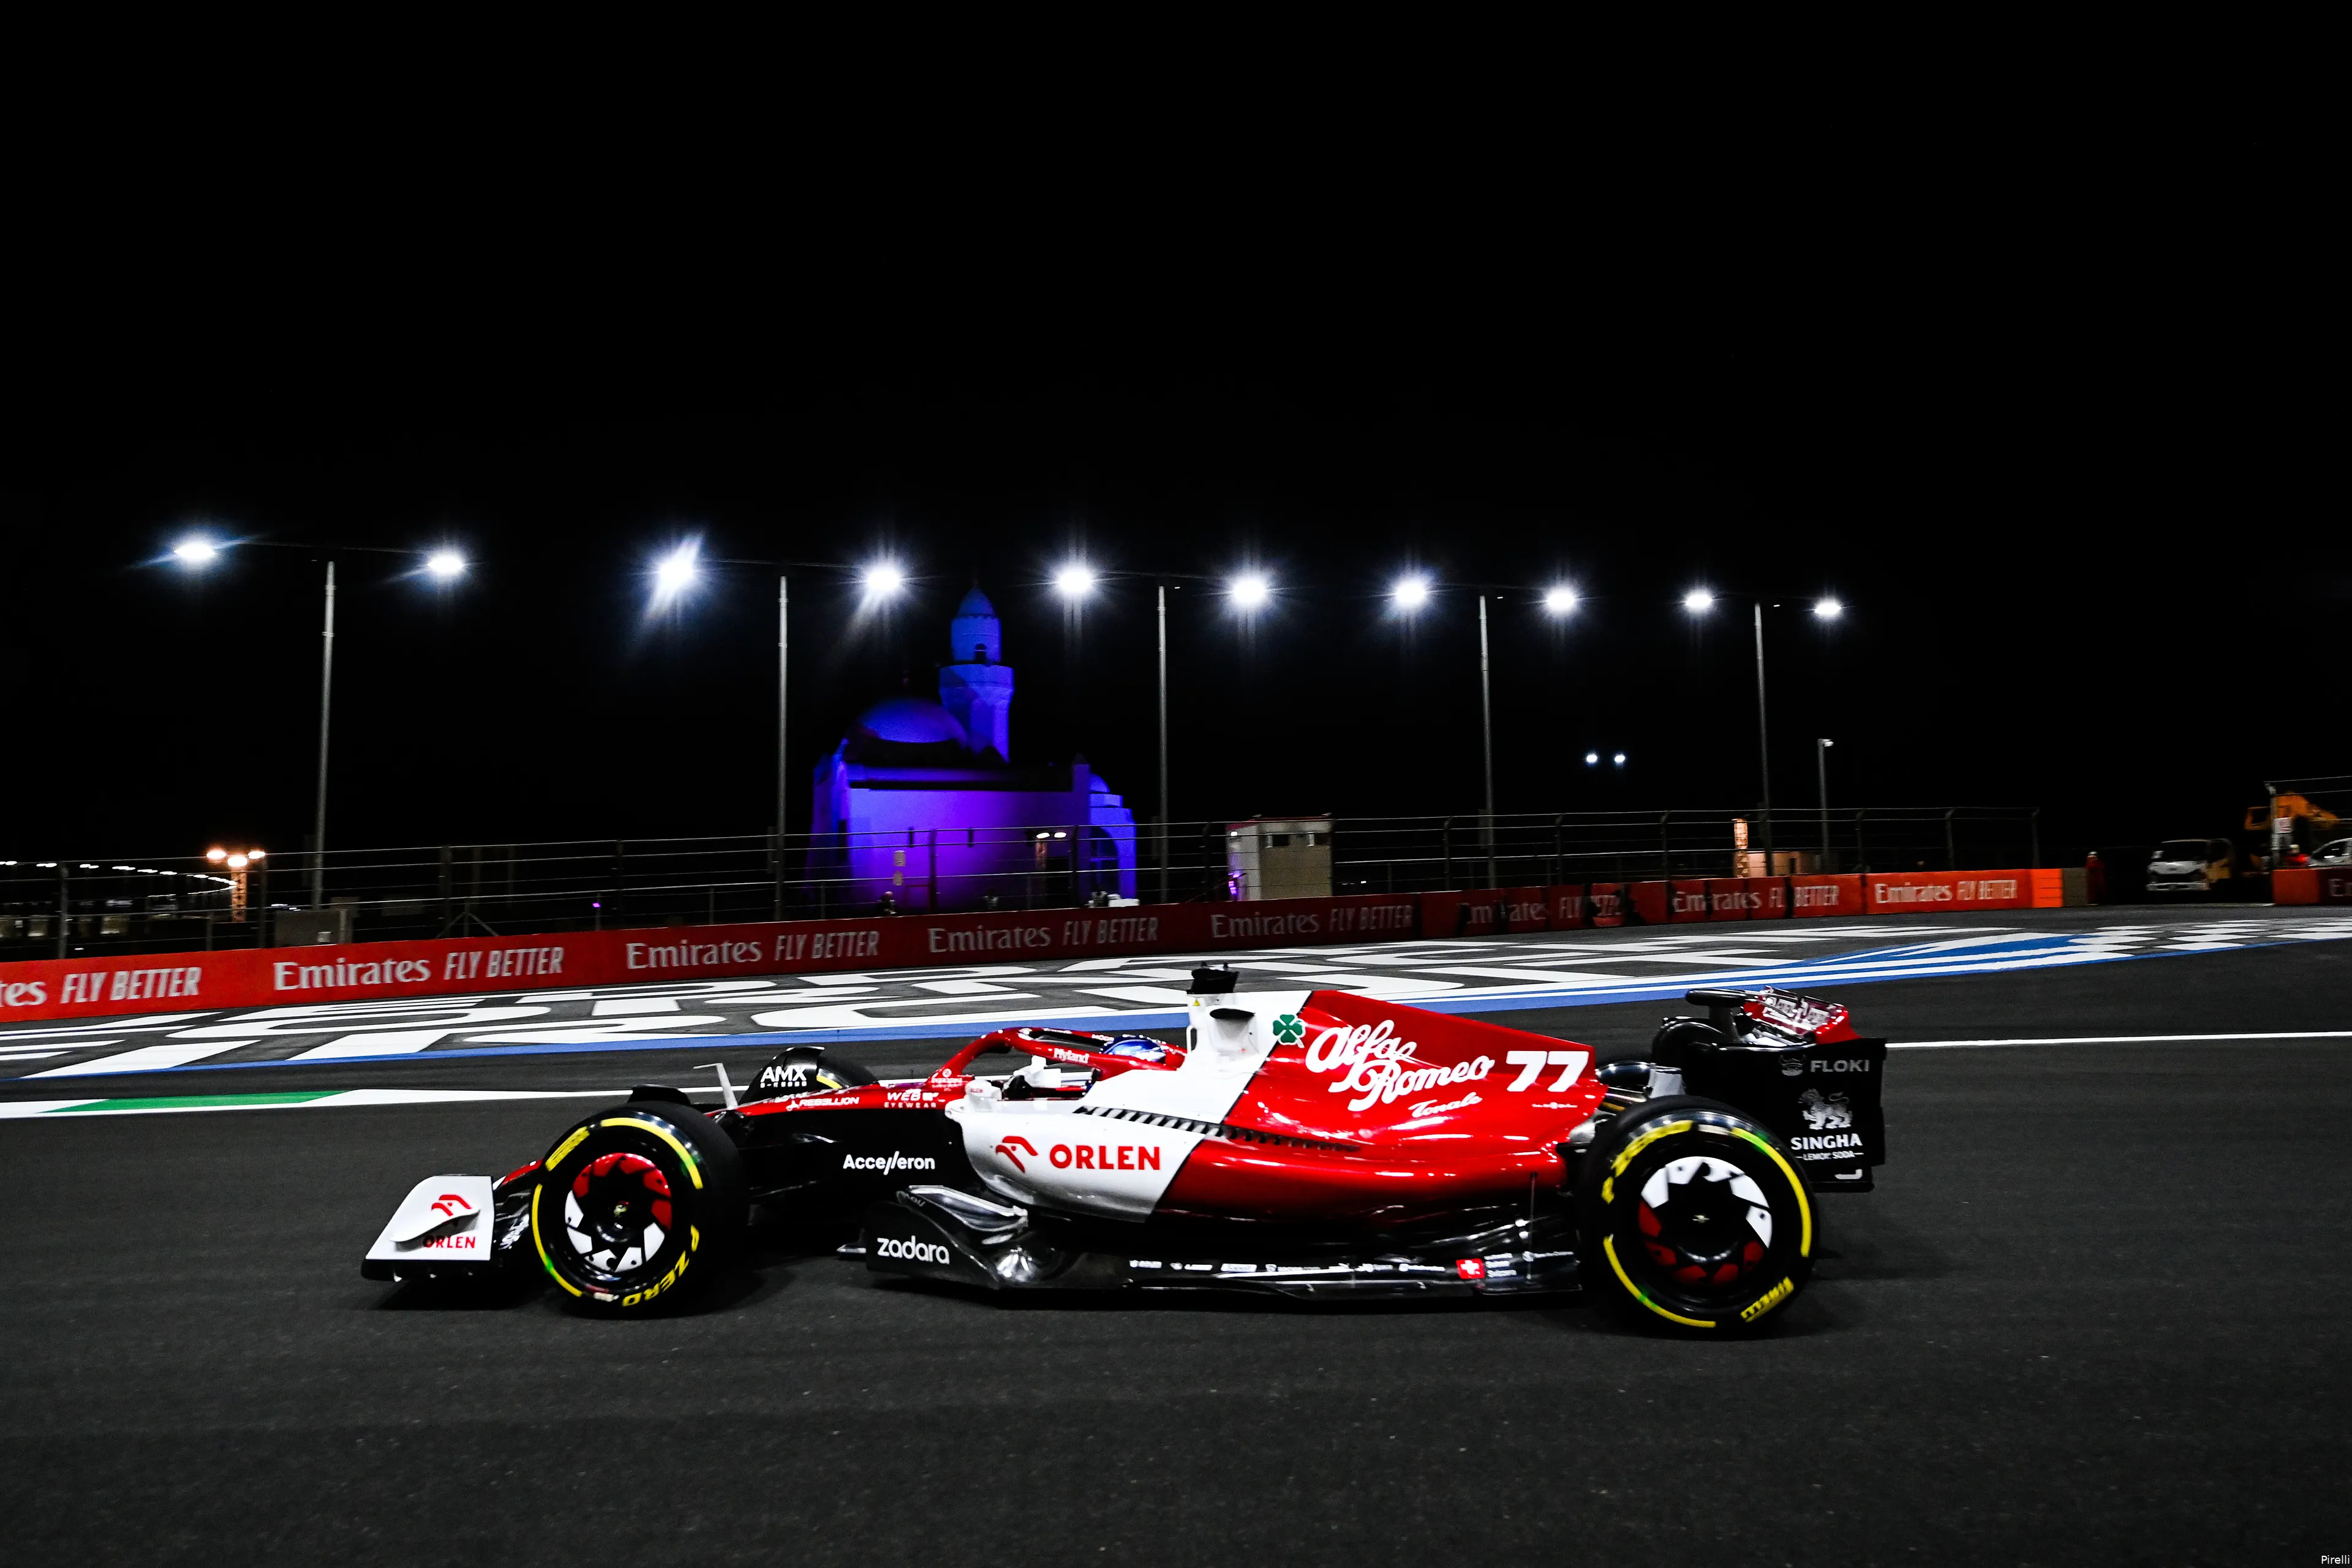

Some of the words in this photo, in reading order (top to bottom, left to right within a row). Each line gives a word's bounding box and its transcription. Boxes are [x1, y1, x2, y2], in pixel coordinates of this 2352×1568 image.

[929, 925, 1050, 953] Emirates
[1062, 921, 1092, 946] FLY
[1098, 917, 1158, 944] BETTER
[1211, 911, 1319, 938] Emirates
[1359, 905, 1412, 930] BETTER
[627, 940, 761, 969] Emirates
[775, 935, 807, 960] FLY
[812, 930, 880, 959] BETTER
[274, 957, 430, 990] Emirates
[444, 951, 483, 980] FLY
[486, 947, 564, 978] BETTER
[61, 972, 107, 1004] FLY
[110, 967, 202, 1001] BETTER
[1305, 1019, 1417, 1093] Alfa
[1506, 1051, 1589, 1092] 77
[1811, 1060, 1870, 1072] FLOKI
[760, 1065, 807, 1083] AMX
[1348, 1055, 1496, 1112] Romeo
[799, 1096, 860, 1107] REBELLION
[1408, 1091, 1483, 1118] Tonale
[1049, 1144, 1160, 1170] ORLEN
[1790, 1133, 1863, 1150] SINGHA
[423, 1236, 476, 1249] ORLEN
[877, 1236, 950, 1265] zadara
[622, 1251, 690, 1306] ZERO
